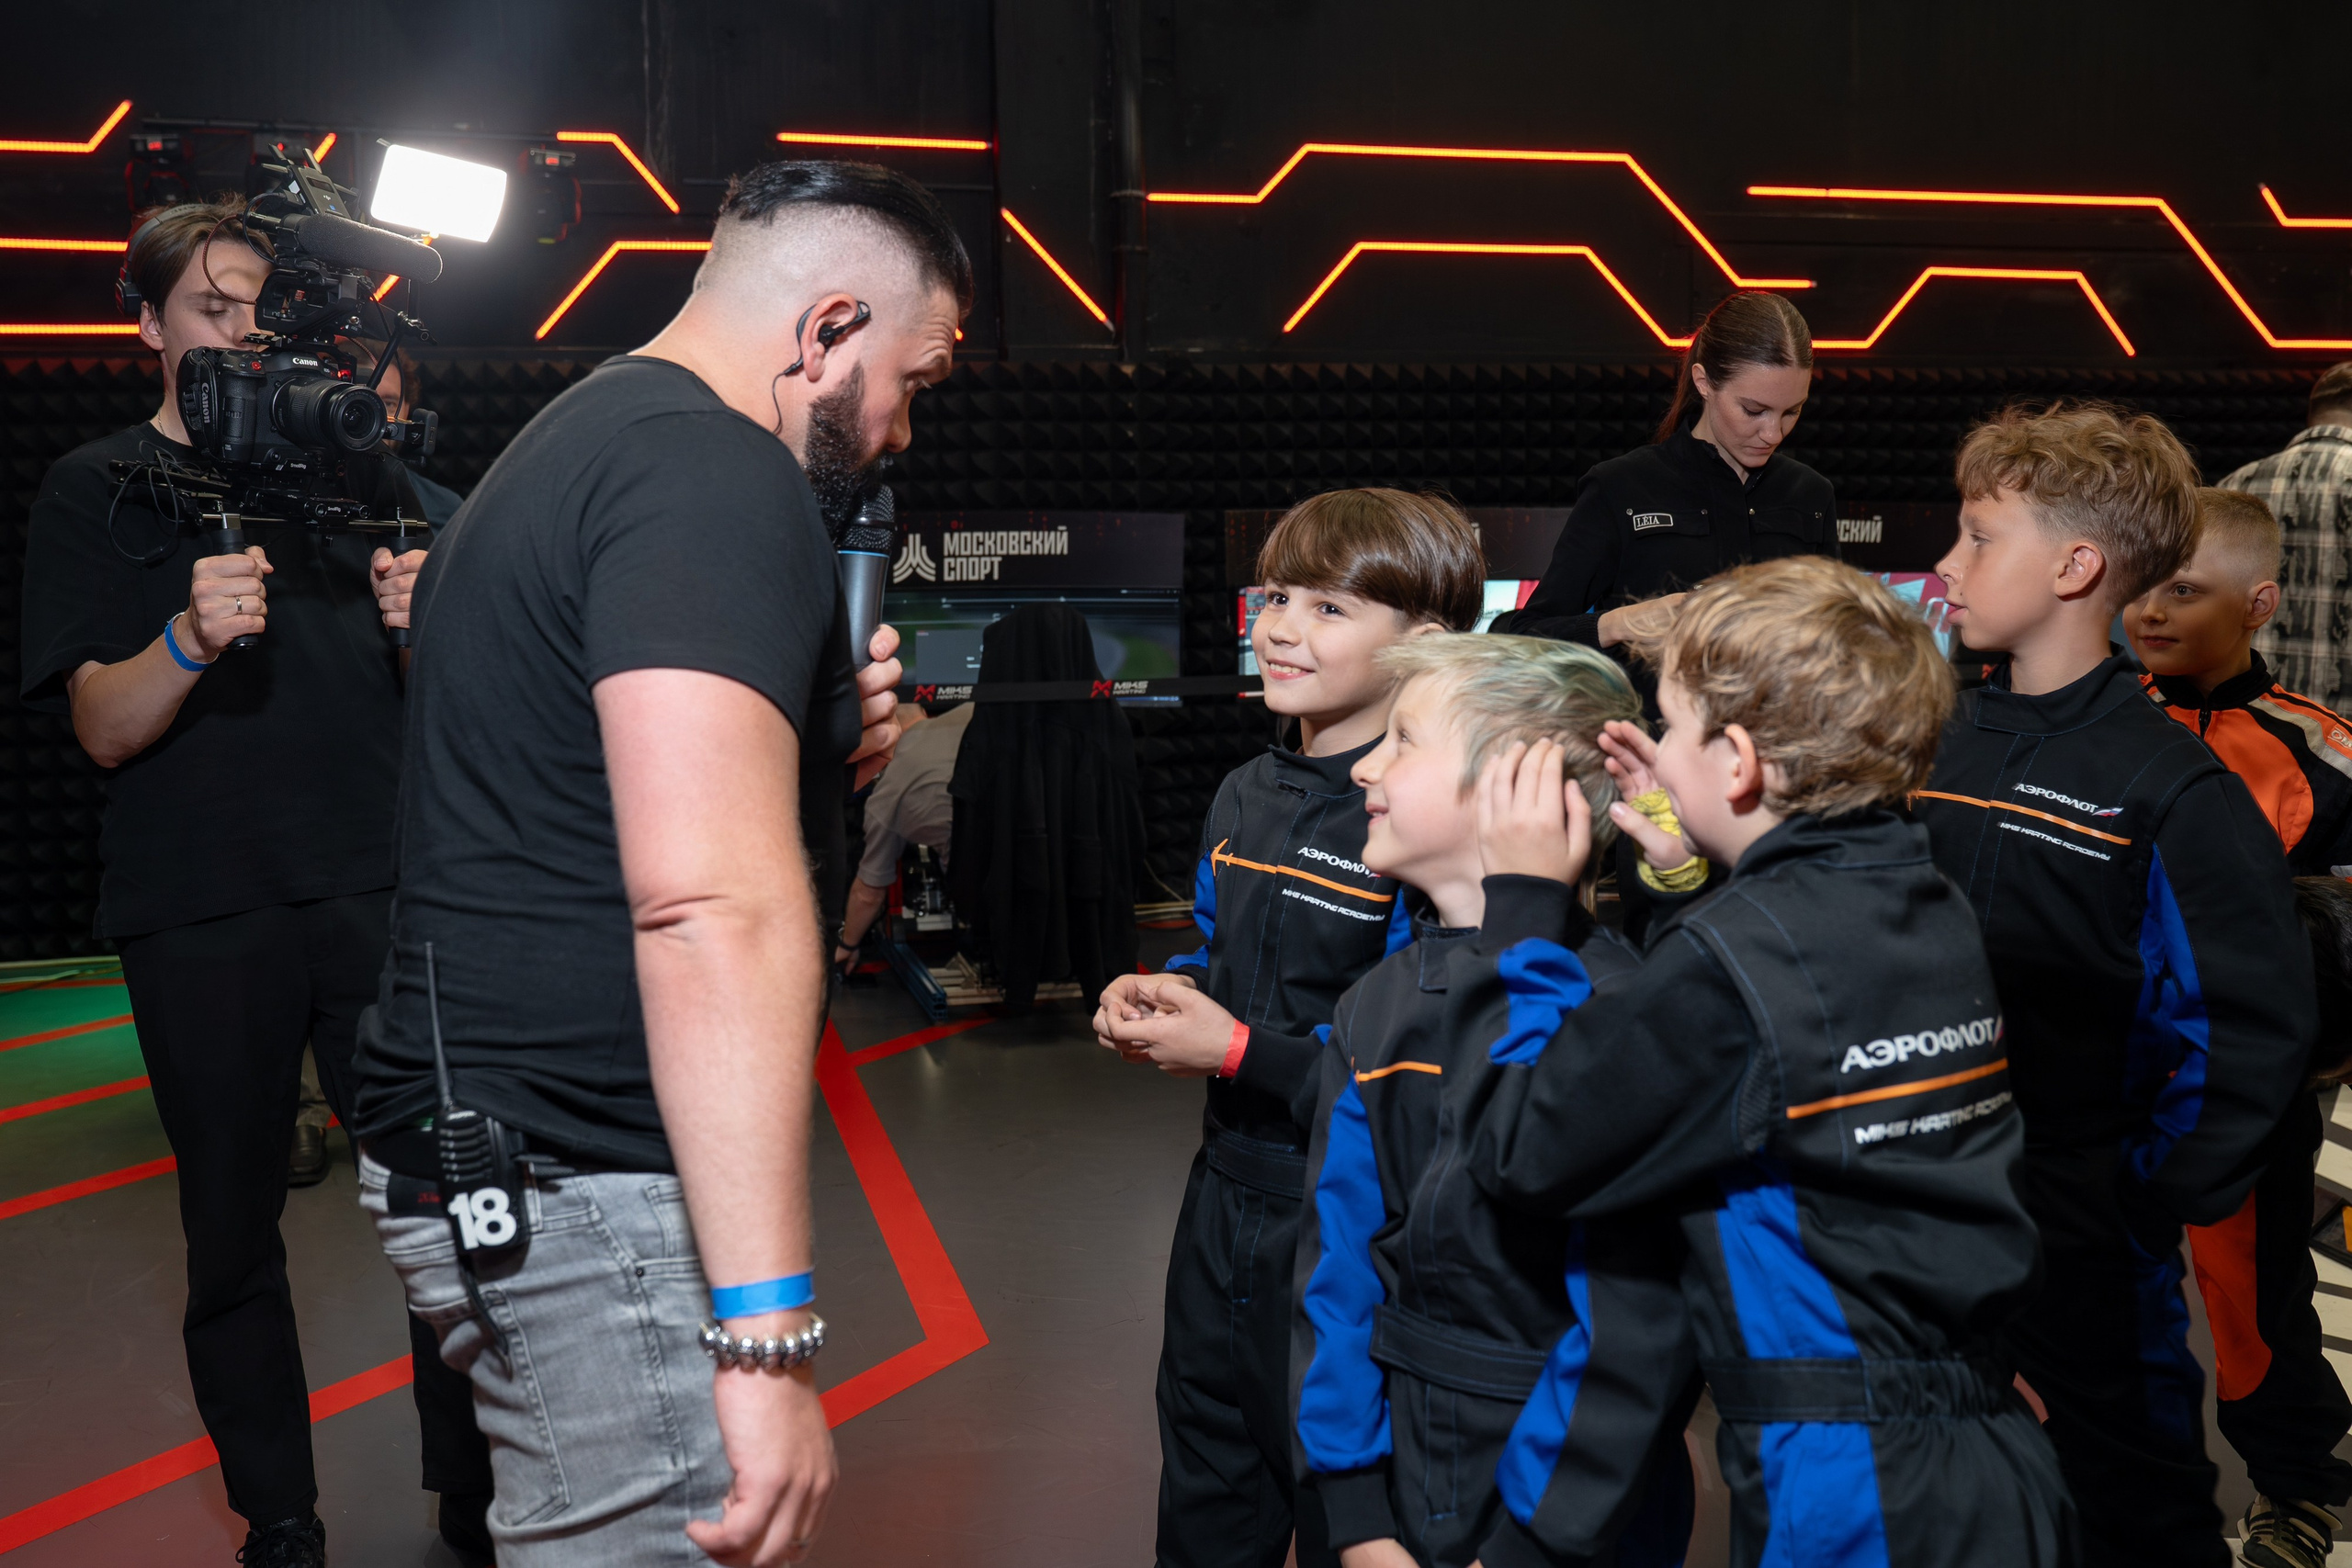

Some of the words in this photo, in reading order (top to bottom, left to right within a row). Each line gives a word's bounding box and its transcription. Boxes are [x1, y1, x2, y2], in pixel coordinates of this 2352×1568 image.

[292, 356, 318, 367] Canon
[201, 381, 210, 423] Canon
[943, 525, 1069, 555] МОСКОВСКИЙ
[943, 557, 1002, 581] СПОРТ
[2014, 783, 2098, 813] АЭРОФЛОТ
[2021, 827, 2063, 845] KARTING
[2062, 841, 2111, 862] ACADEMY
[1300, 894, 1338, 911] KARTING
[1337, 907, 1385, 921] ACADEMY
[1840, 1018, 1995, 1074] АЭРОФЛОТ
[1910, 1103, 1974, 1134] KARTING
[447, 1187, 516, 1250] 18
